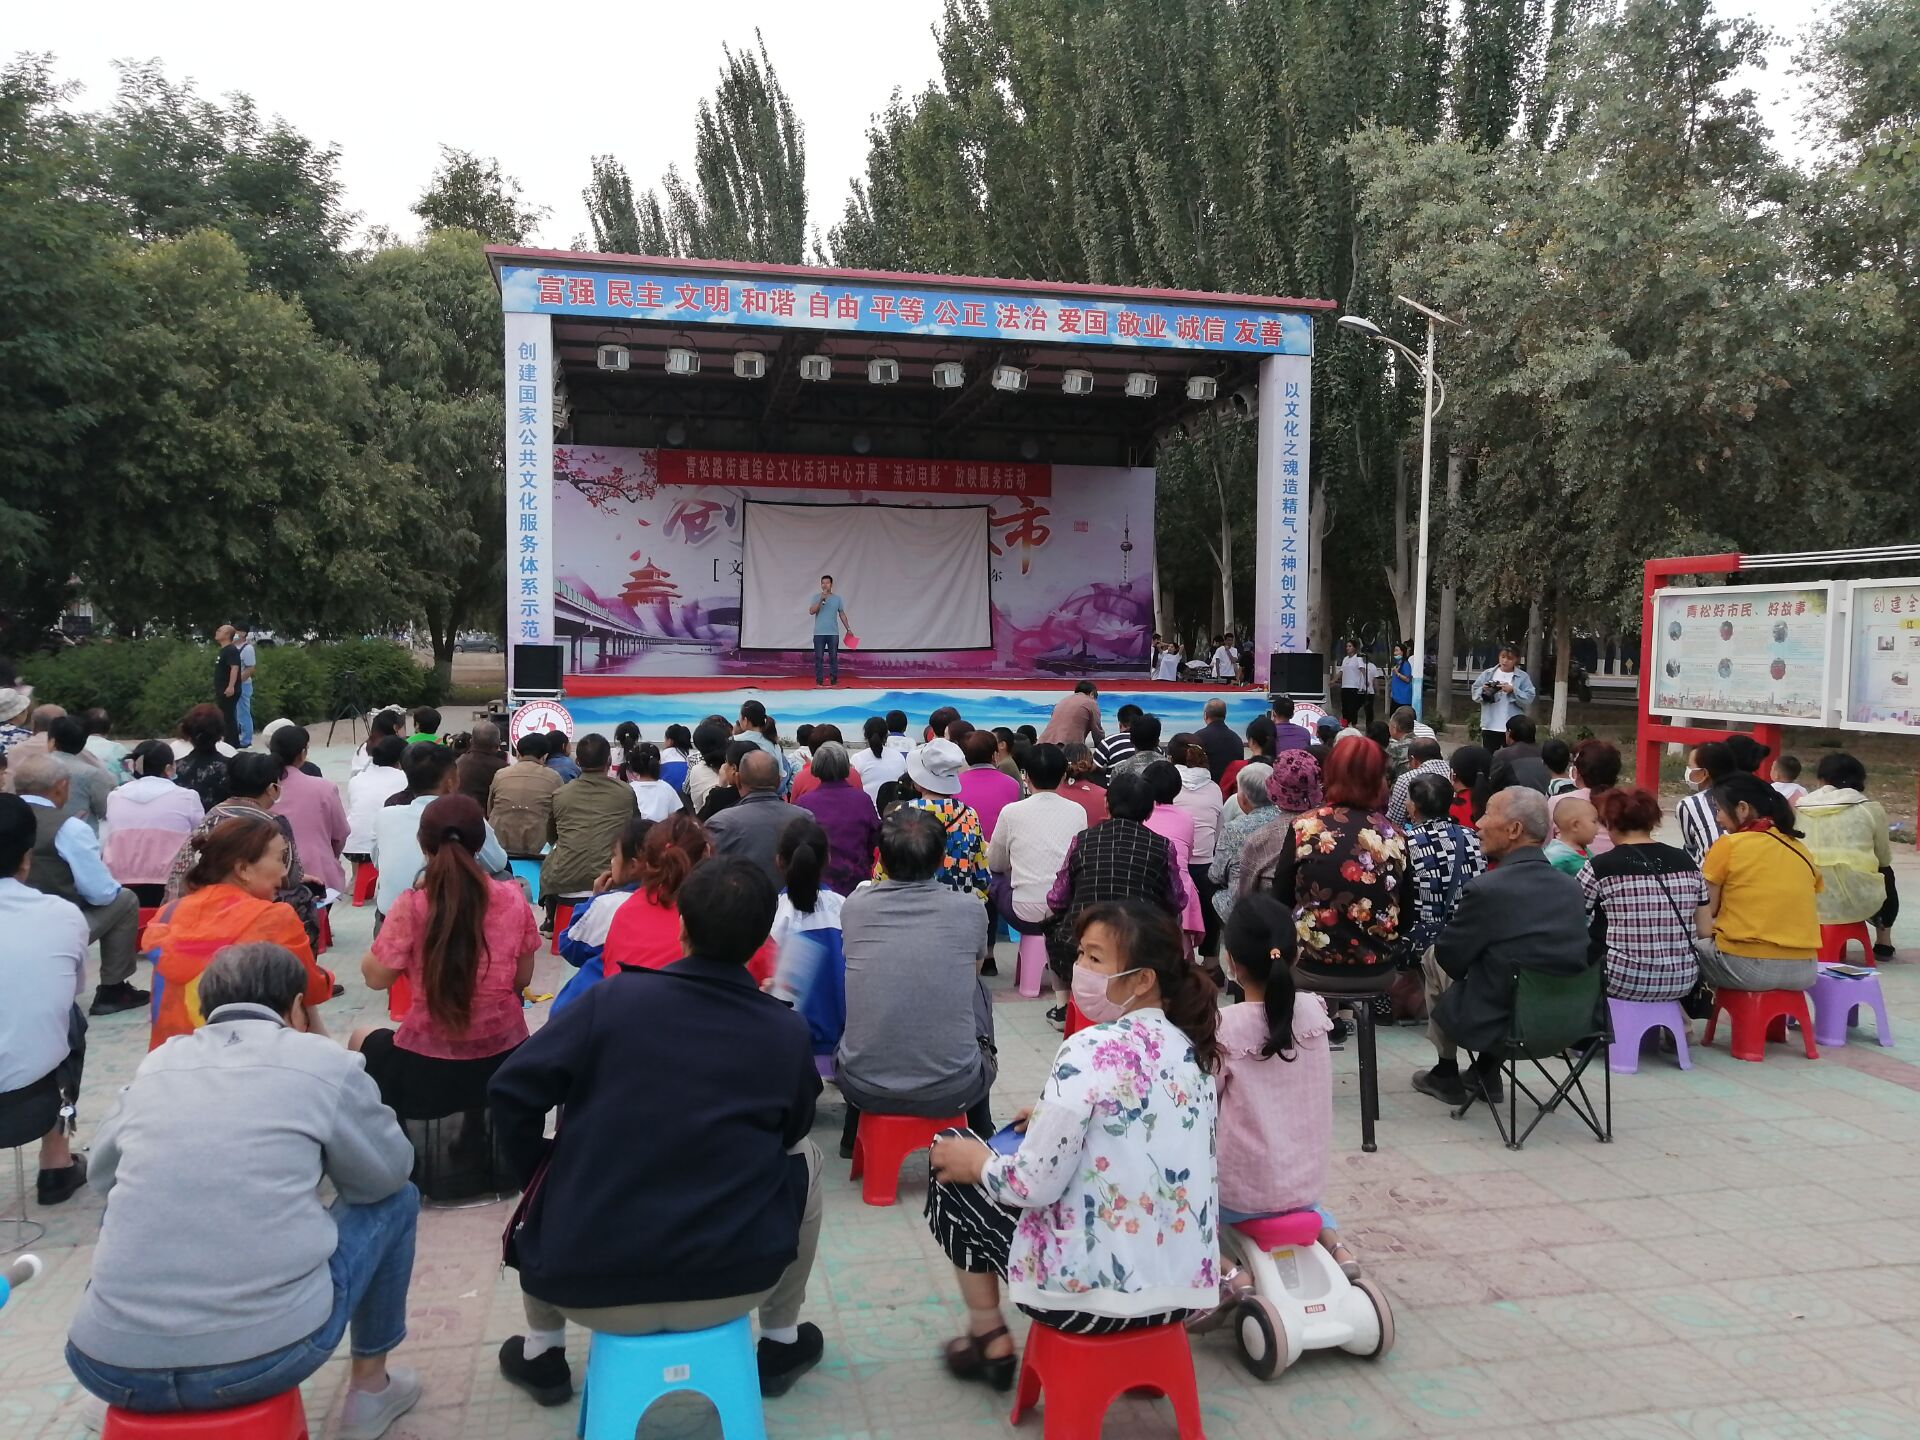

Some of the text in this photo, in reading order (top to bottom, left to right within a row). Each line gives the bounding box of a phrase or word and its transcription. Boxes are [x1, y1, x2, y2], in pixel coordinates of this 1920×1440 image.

[537, 275, 1283, 347] 富强 民主 文明 和谐 自由 平等 公正 法治 爱国 敬业 诚信 友善
[518, 342, 540, 644] 创建国家公共文化服务体系示范
[1280, 382, 1300, 648] 以文化之魂造精气之神创文明之
